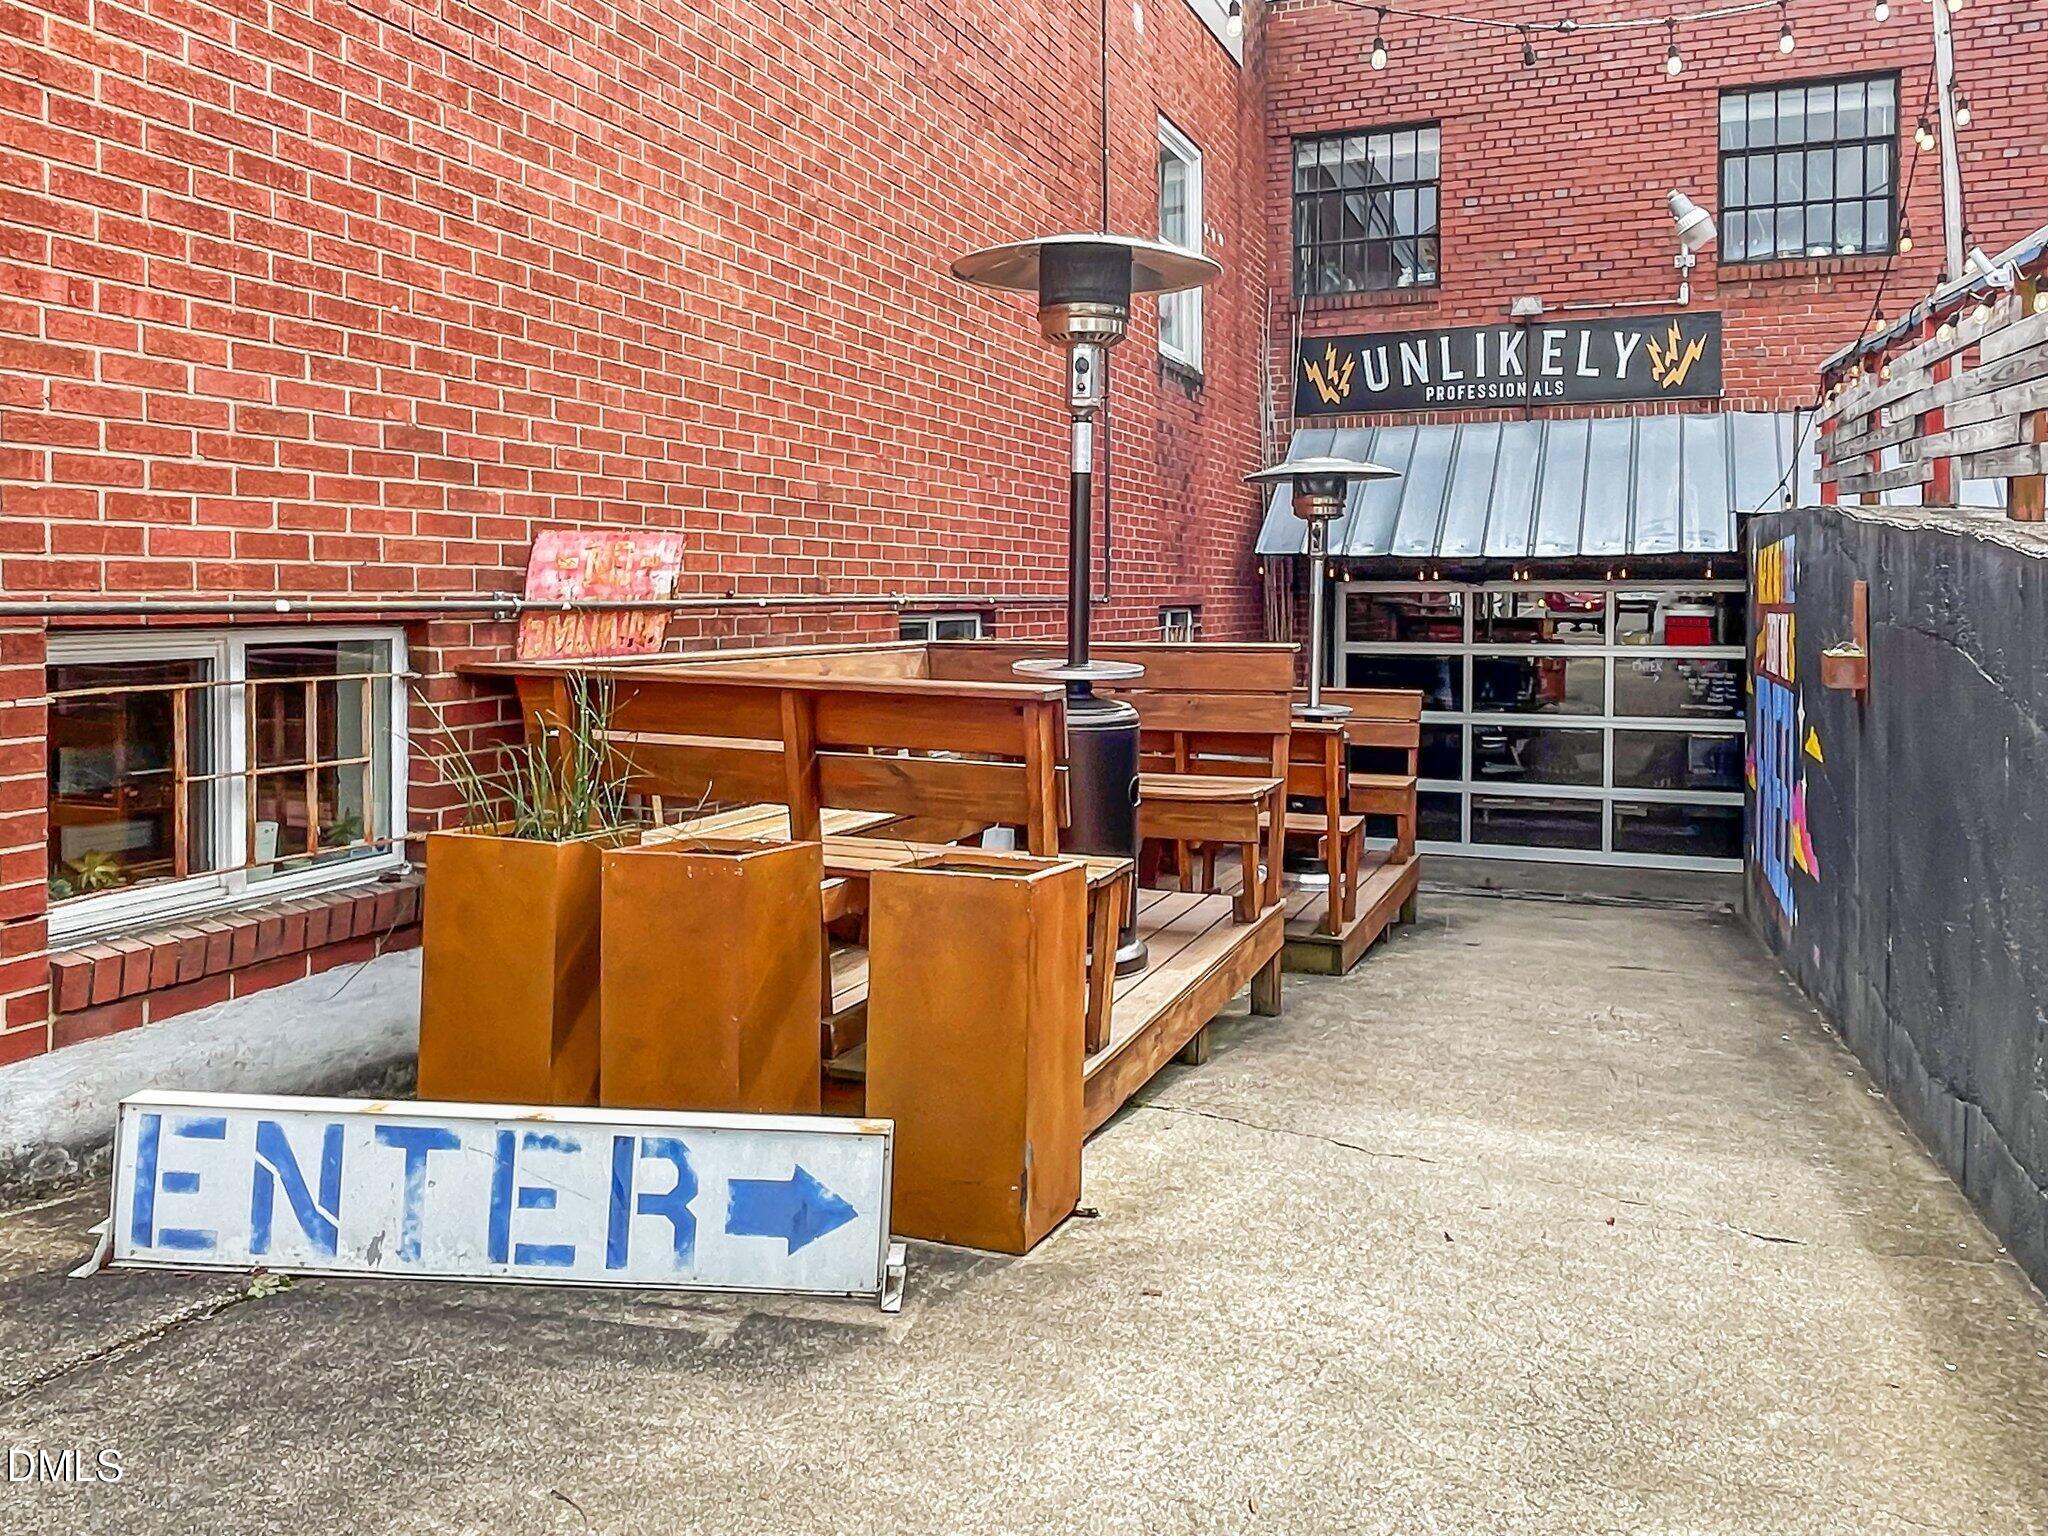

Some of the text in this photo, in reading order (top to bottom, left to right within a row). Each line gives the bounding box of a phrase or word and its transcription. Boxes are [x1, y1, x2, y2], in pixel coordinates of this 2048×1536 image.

[1361, 329, 1642, 392] UNLIKELY
[1425, 380, 1565, 402] PROFESSIONALS
[130, 1113, 698, 1271] ENTER
